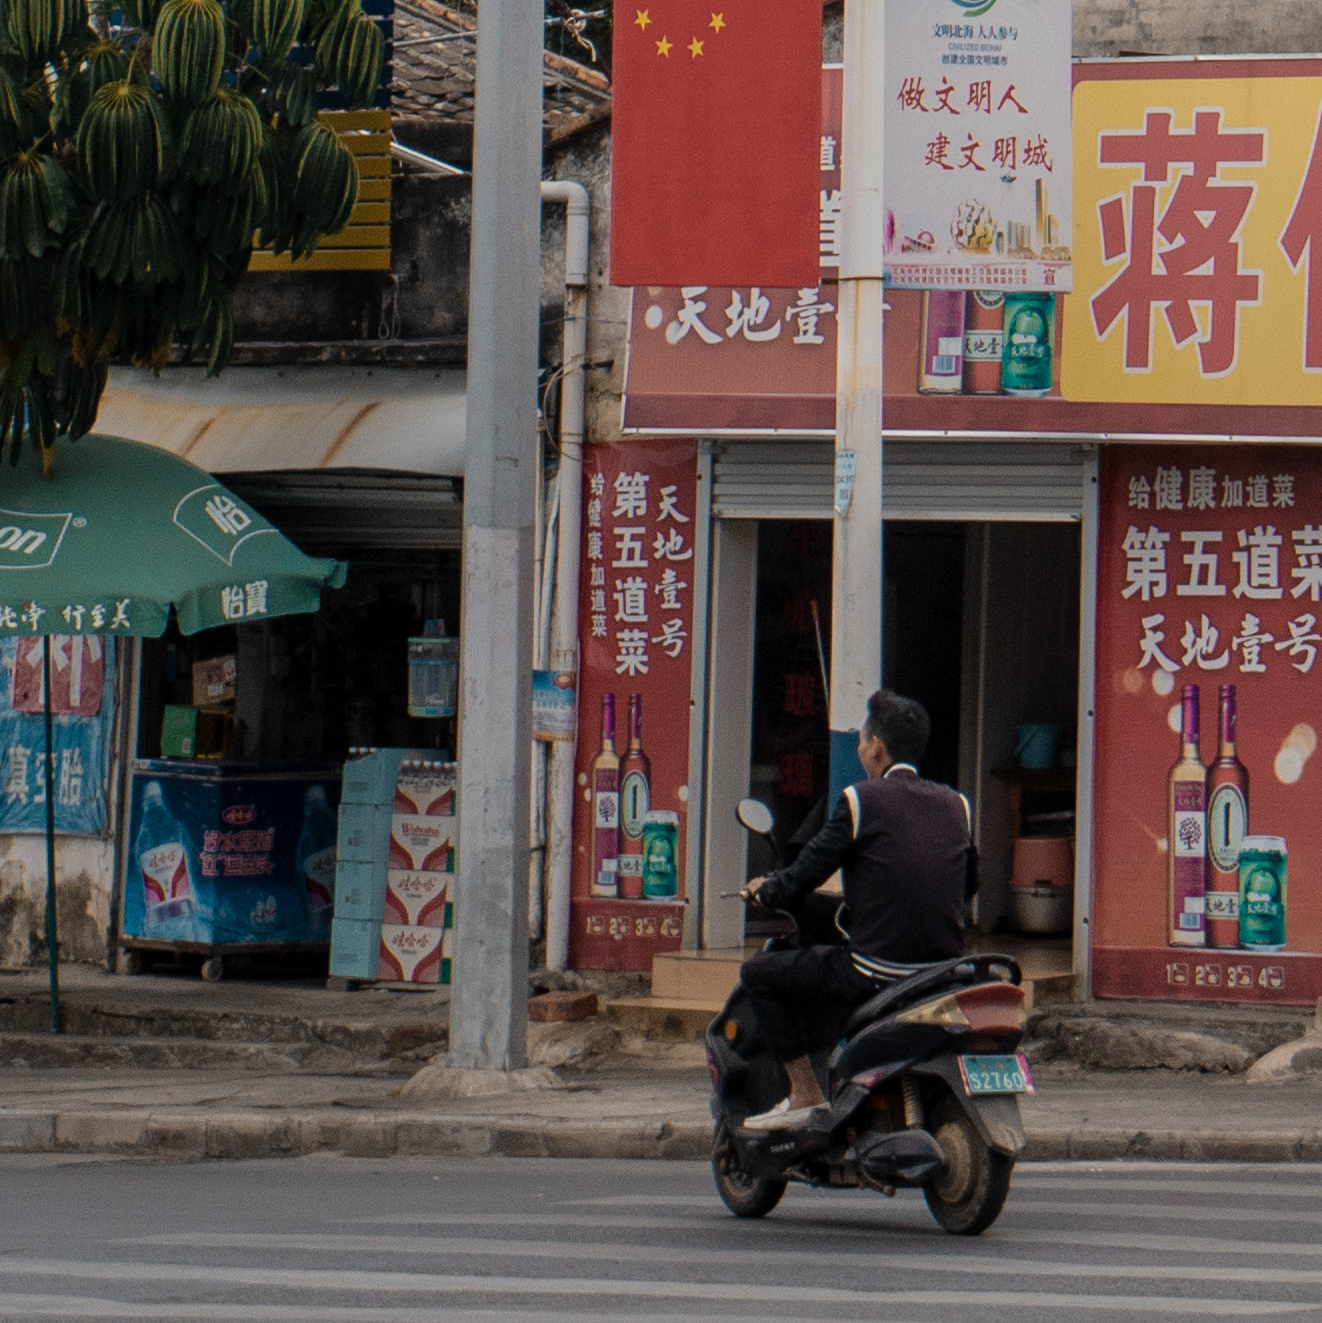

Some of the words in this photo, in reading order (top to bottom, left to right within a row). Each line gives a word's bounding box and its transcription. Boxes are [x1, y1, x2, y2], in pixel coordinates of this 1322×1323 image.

[933, 24, 974, 39] 文明北海
[897, 75, 1029, 115] 做文明人
[925, 131, 1053, 173] 建文明城
[665, 286, 890, 345] 天地壹
[1128, 465, 1295, 510] 给健康加道菜
[587, 473, 607, 638] 给健康加道菜
[612, 472, 649, 676] 第五道菜
[651, 484, 693, 659] 天地壹号
[1136, 612, 1322, 673] 天地壹号
